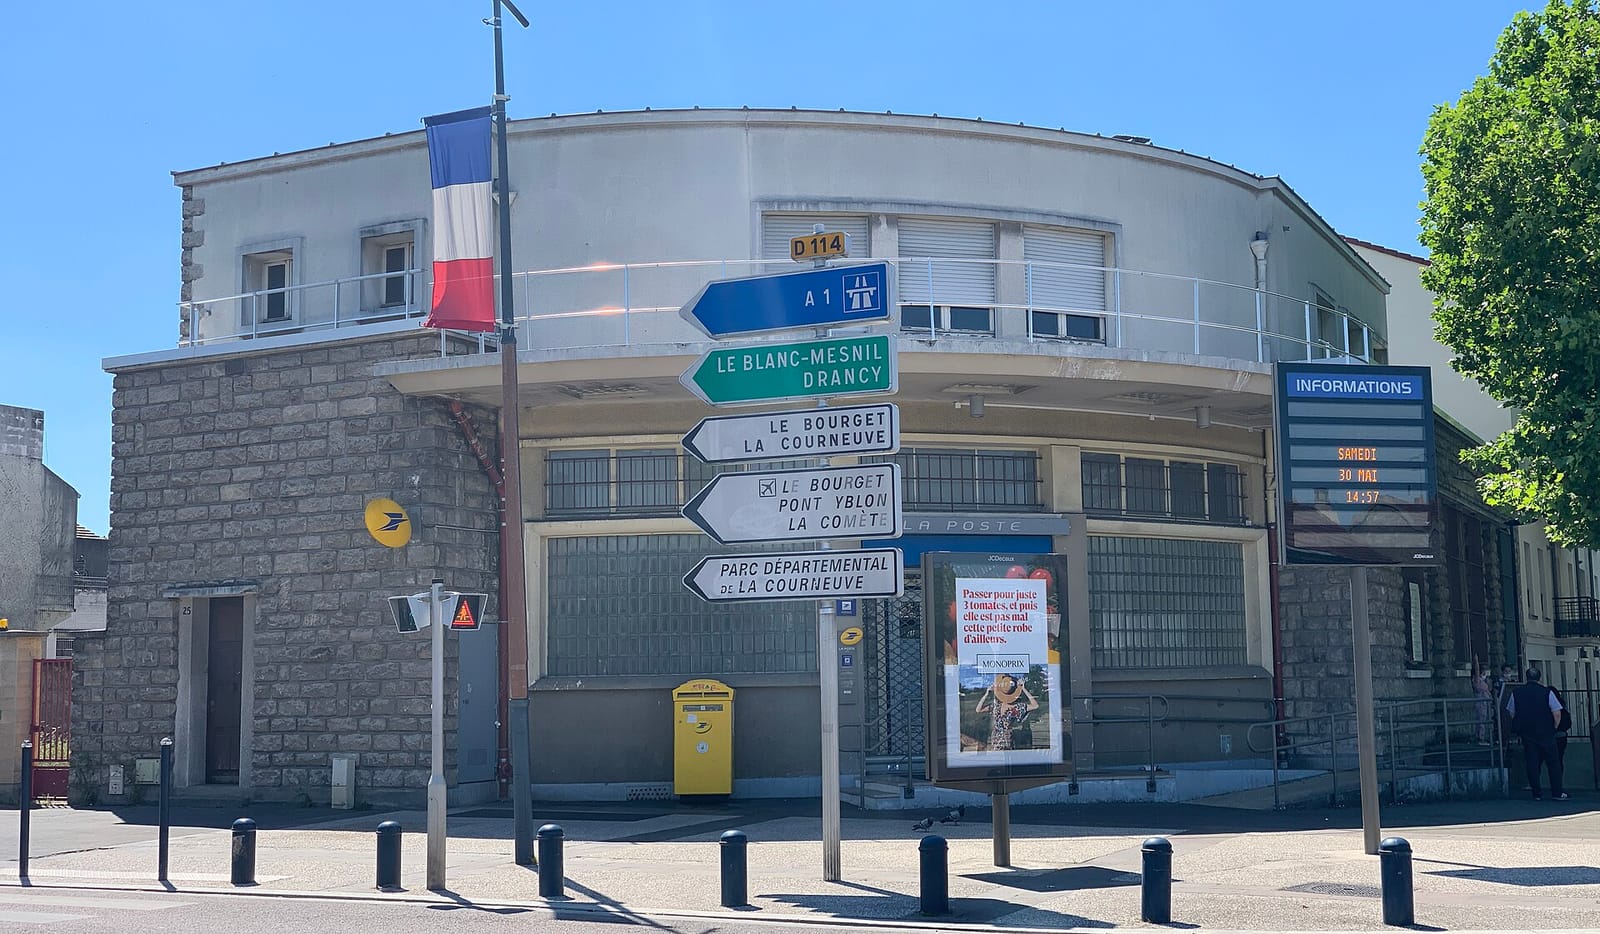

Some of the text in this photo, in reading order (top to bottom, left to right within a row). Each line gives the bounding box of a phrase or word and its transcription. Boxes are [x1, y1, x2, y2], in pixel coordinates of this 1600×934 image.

[794, 235, 842, 256] D 114
[805, 288, 831, 307] A 1
[717, 343, 882, 373] LE BLANC-MESNIL
[803, 366, 882, 389] DRANCY
[1296, 379, 1412, 394] INFORMATIONS
[770, 412, 886, 434] LE BOURGET
[744, 430, 886, 453] LA COURNEUVE
[1338, 447, 1377, 461] SAMEDI
[782, 474, 885, 494] LE BOURGET
[1339, 469, 1377, 482] 30 MAI
[779, 493, 888, 513] PONT YBLON
[1346, 491, 1379, 504] 14:57
[788, 510, 888, 531] LA COMÈTE
[903, 520, 1022, 532] LA POSTE
[720, 557, 889, 577] PARC DÉPARTEMENTAL
[720, 575, 864, 594] DE LA COURNEUVE
[963, 589, 1037, 601] Passer pour juste
[964, 601, 1038, 612] 3 tomates, et puis
[963, 612, 1028, 623] elle est pas mal
[963, 623, 1033, 634] cette petite robe
[982, 660, 1025, 668] MONOPRIX
